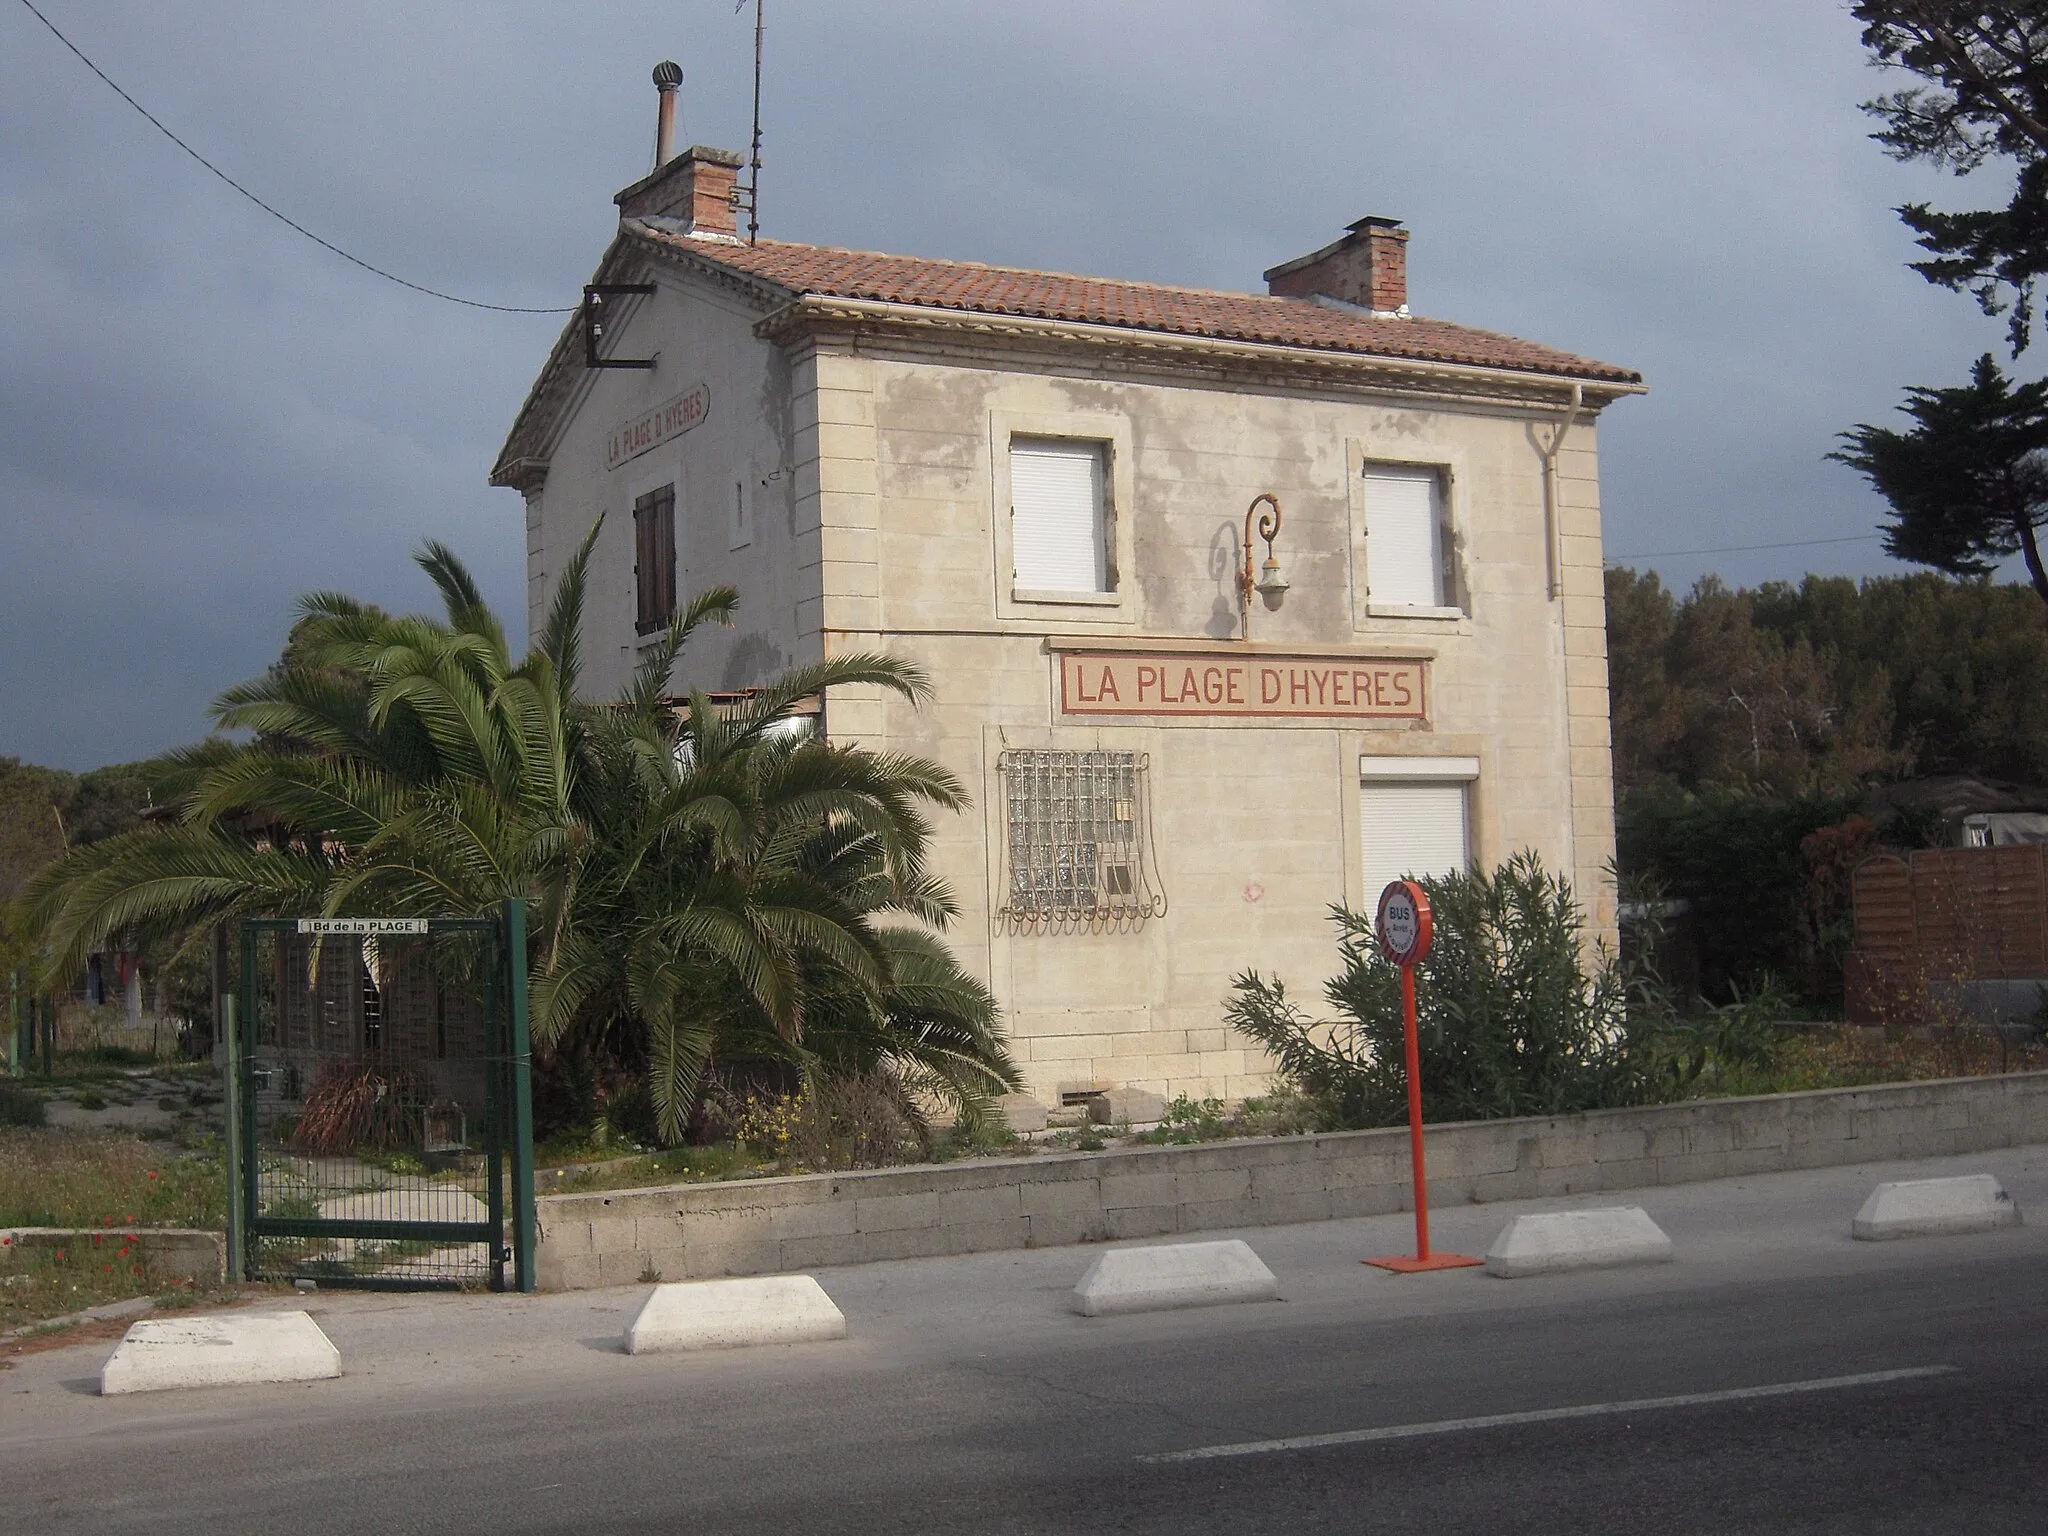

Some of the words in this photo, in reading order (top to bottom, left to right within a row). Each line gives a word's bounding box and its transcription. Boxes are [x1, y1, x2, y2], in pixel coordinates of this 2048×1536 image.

[608, 436, 620, 462] LA
[623, 419, 651, 455] PLAGE
[1077, 664, 1120, 702] LA
[1137, 665, 1244, 705] PLAGE
[1261, 668, 1411, 706] D'HYERES
[313, 921, 330, 931] Bd
[333, 921, 349, 931] de
[353, 921, 365, 931] la
[369, 921, 412, 931] PLAGE
[1389, 906, 1410, 920] BUS
